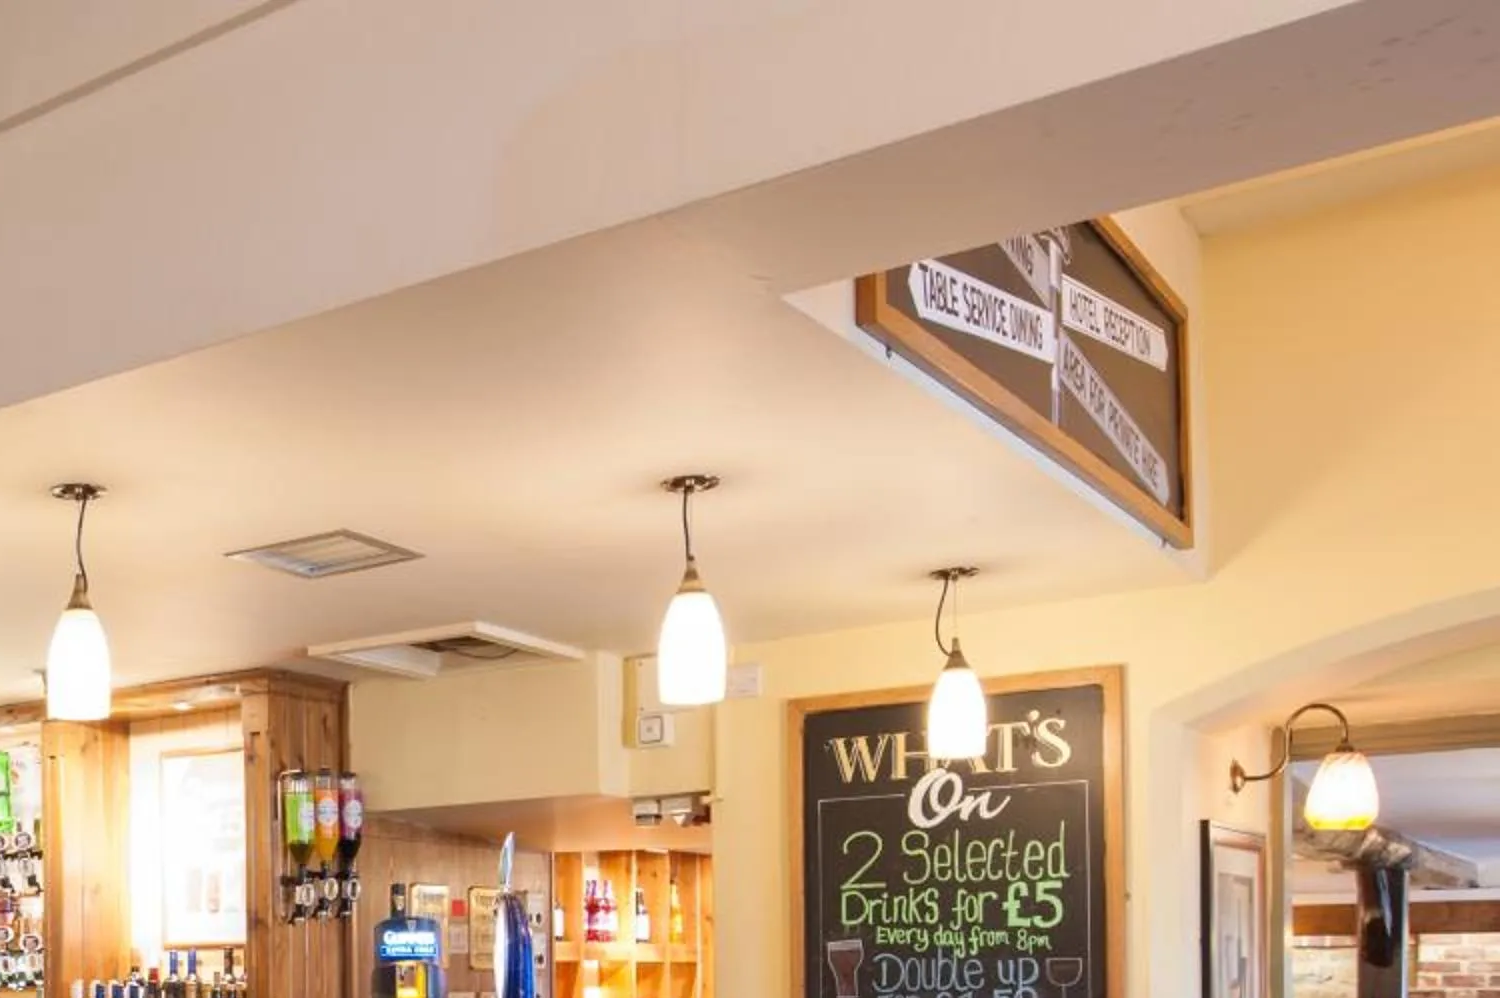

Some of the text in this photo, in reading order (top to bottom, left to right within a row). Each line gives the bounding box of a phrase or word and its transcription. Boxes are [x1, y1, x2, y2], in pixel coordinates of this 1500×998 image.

[918, 263, 1043, 350] TABLE SERVICE DINING
[1070, 287, 1151, 355] HOTEL RECEPTION
[825, 710, 1071, 783] WHT'S
[908, 769, 1011, 828] On
[840, 821, 1070, 889] 2 Selected
[840, 879, 1064, 929] Drinks for £5
[872, 948, 1040, 998] Double up
[875, 926, 1052, 959] Every day from 8pm
